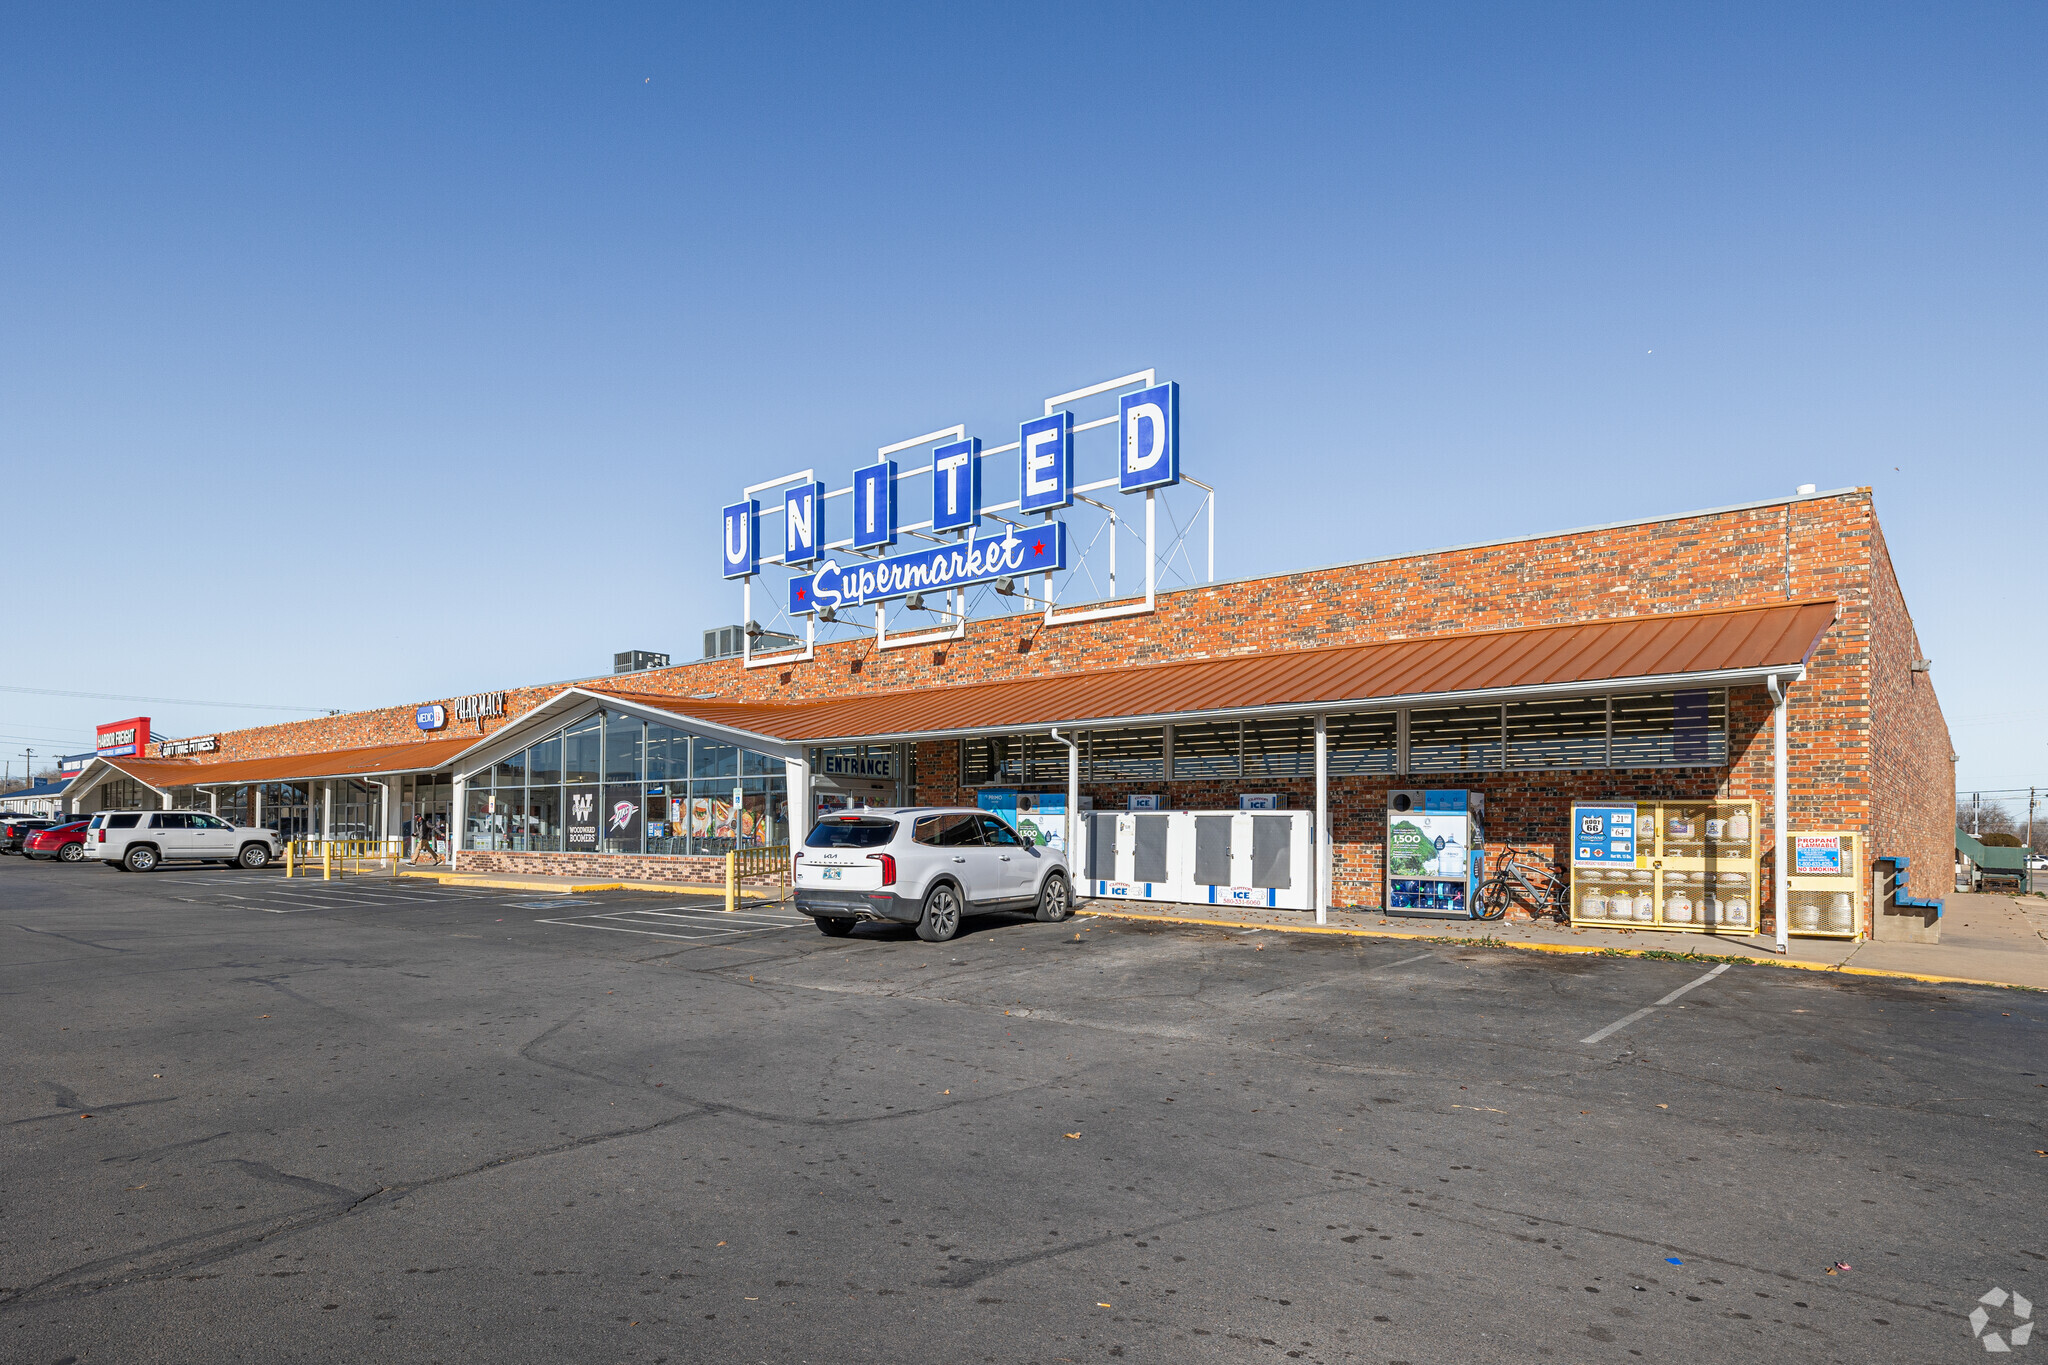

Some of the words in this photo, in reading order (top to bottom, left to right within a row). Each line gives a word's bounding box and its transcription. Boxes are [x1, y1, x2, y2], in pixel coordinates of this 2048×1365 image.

[725, 402, 1166, 564] UNITED
[811, 523, 1025, 611] Supermarket
[417, 712, 434, 723] MEDIC
[454, 692, 504, 731] PHARMACY
[98, 732, 116, 748] HARBOR
[116, 728, 136, 745] FREIGHT
[163, 740, 188, 756] ANYTIME
[188, 736, 215, 753] FITNESS
[826, 756, 889, 775] ENTRANCE
[572, 793, 593, 822] W
[569, 826, 596, 834] WOODWARD
[569, 834, 596, 843] BOOMERS
[1393, 835, 1421, 844] 1,500
